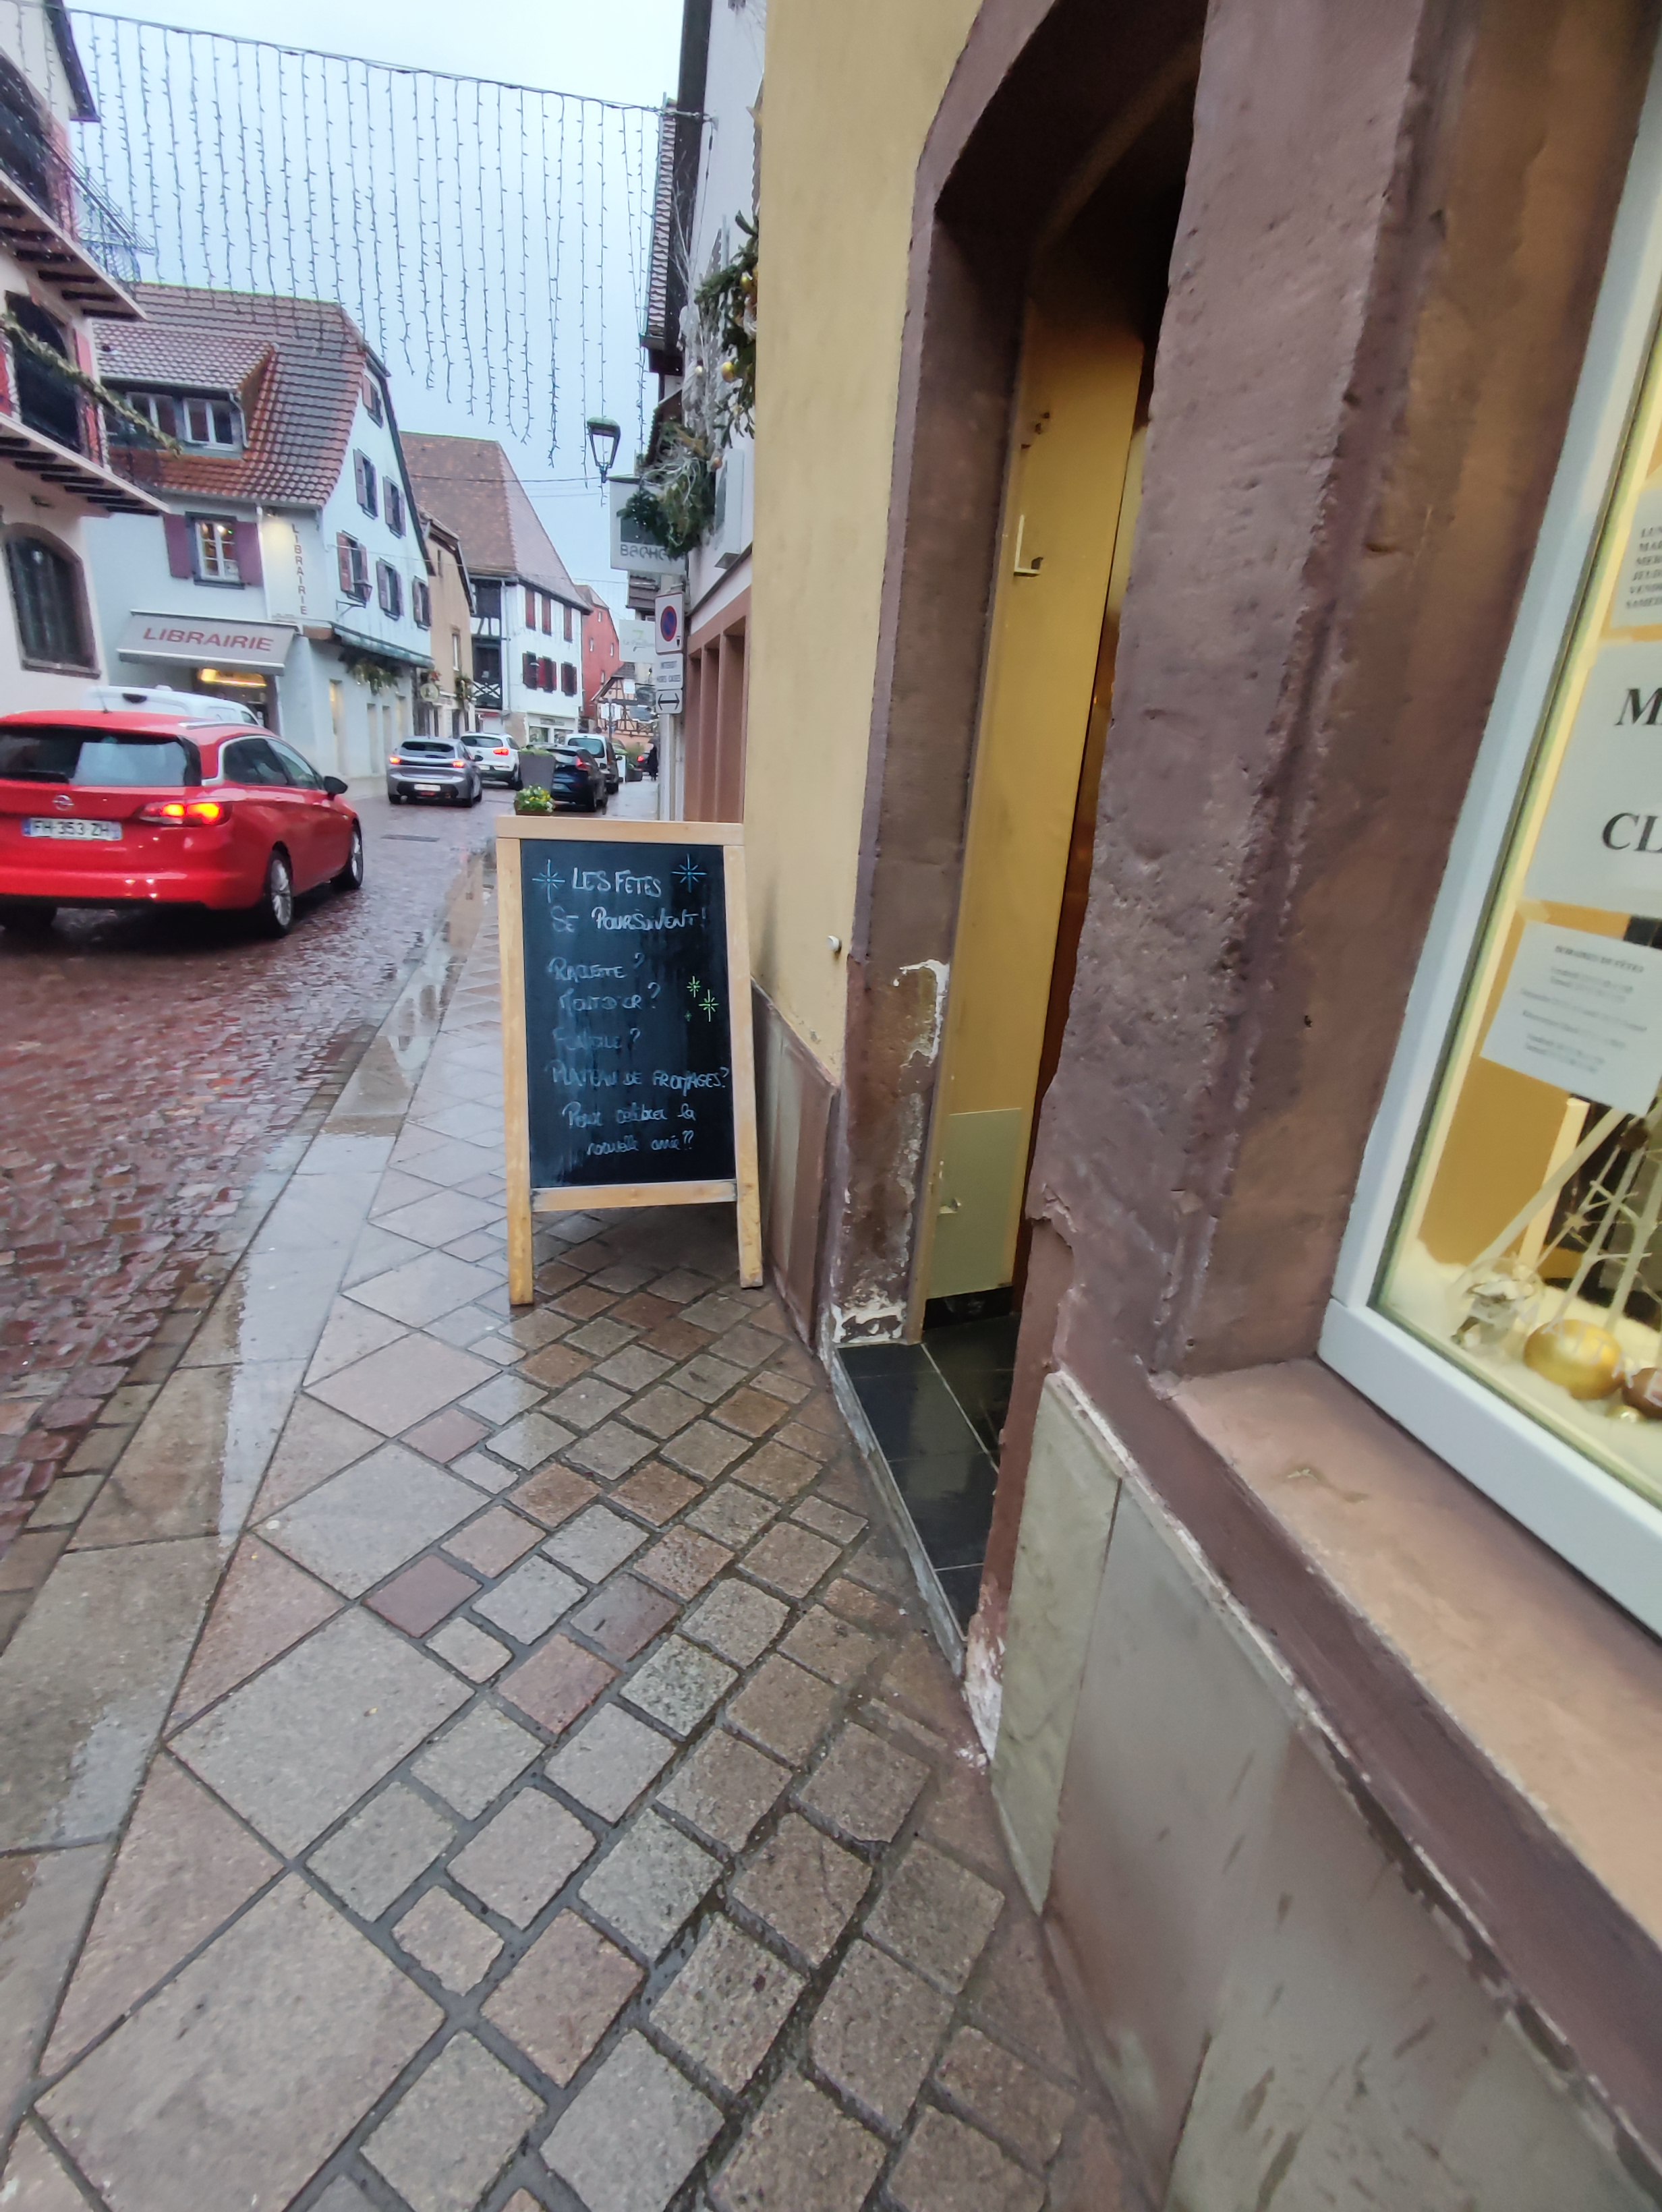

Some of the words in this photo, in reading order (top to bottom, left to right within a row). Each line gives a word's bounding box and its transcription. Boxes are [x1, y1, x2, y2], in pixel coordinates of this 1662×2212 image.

[291, 523, 308, 615] LIBRAIRIE
[142, 627, 274, 652] LIBRAIRIE
[573, 867, 611, 892] LES
